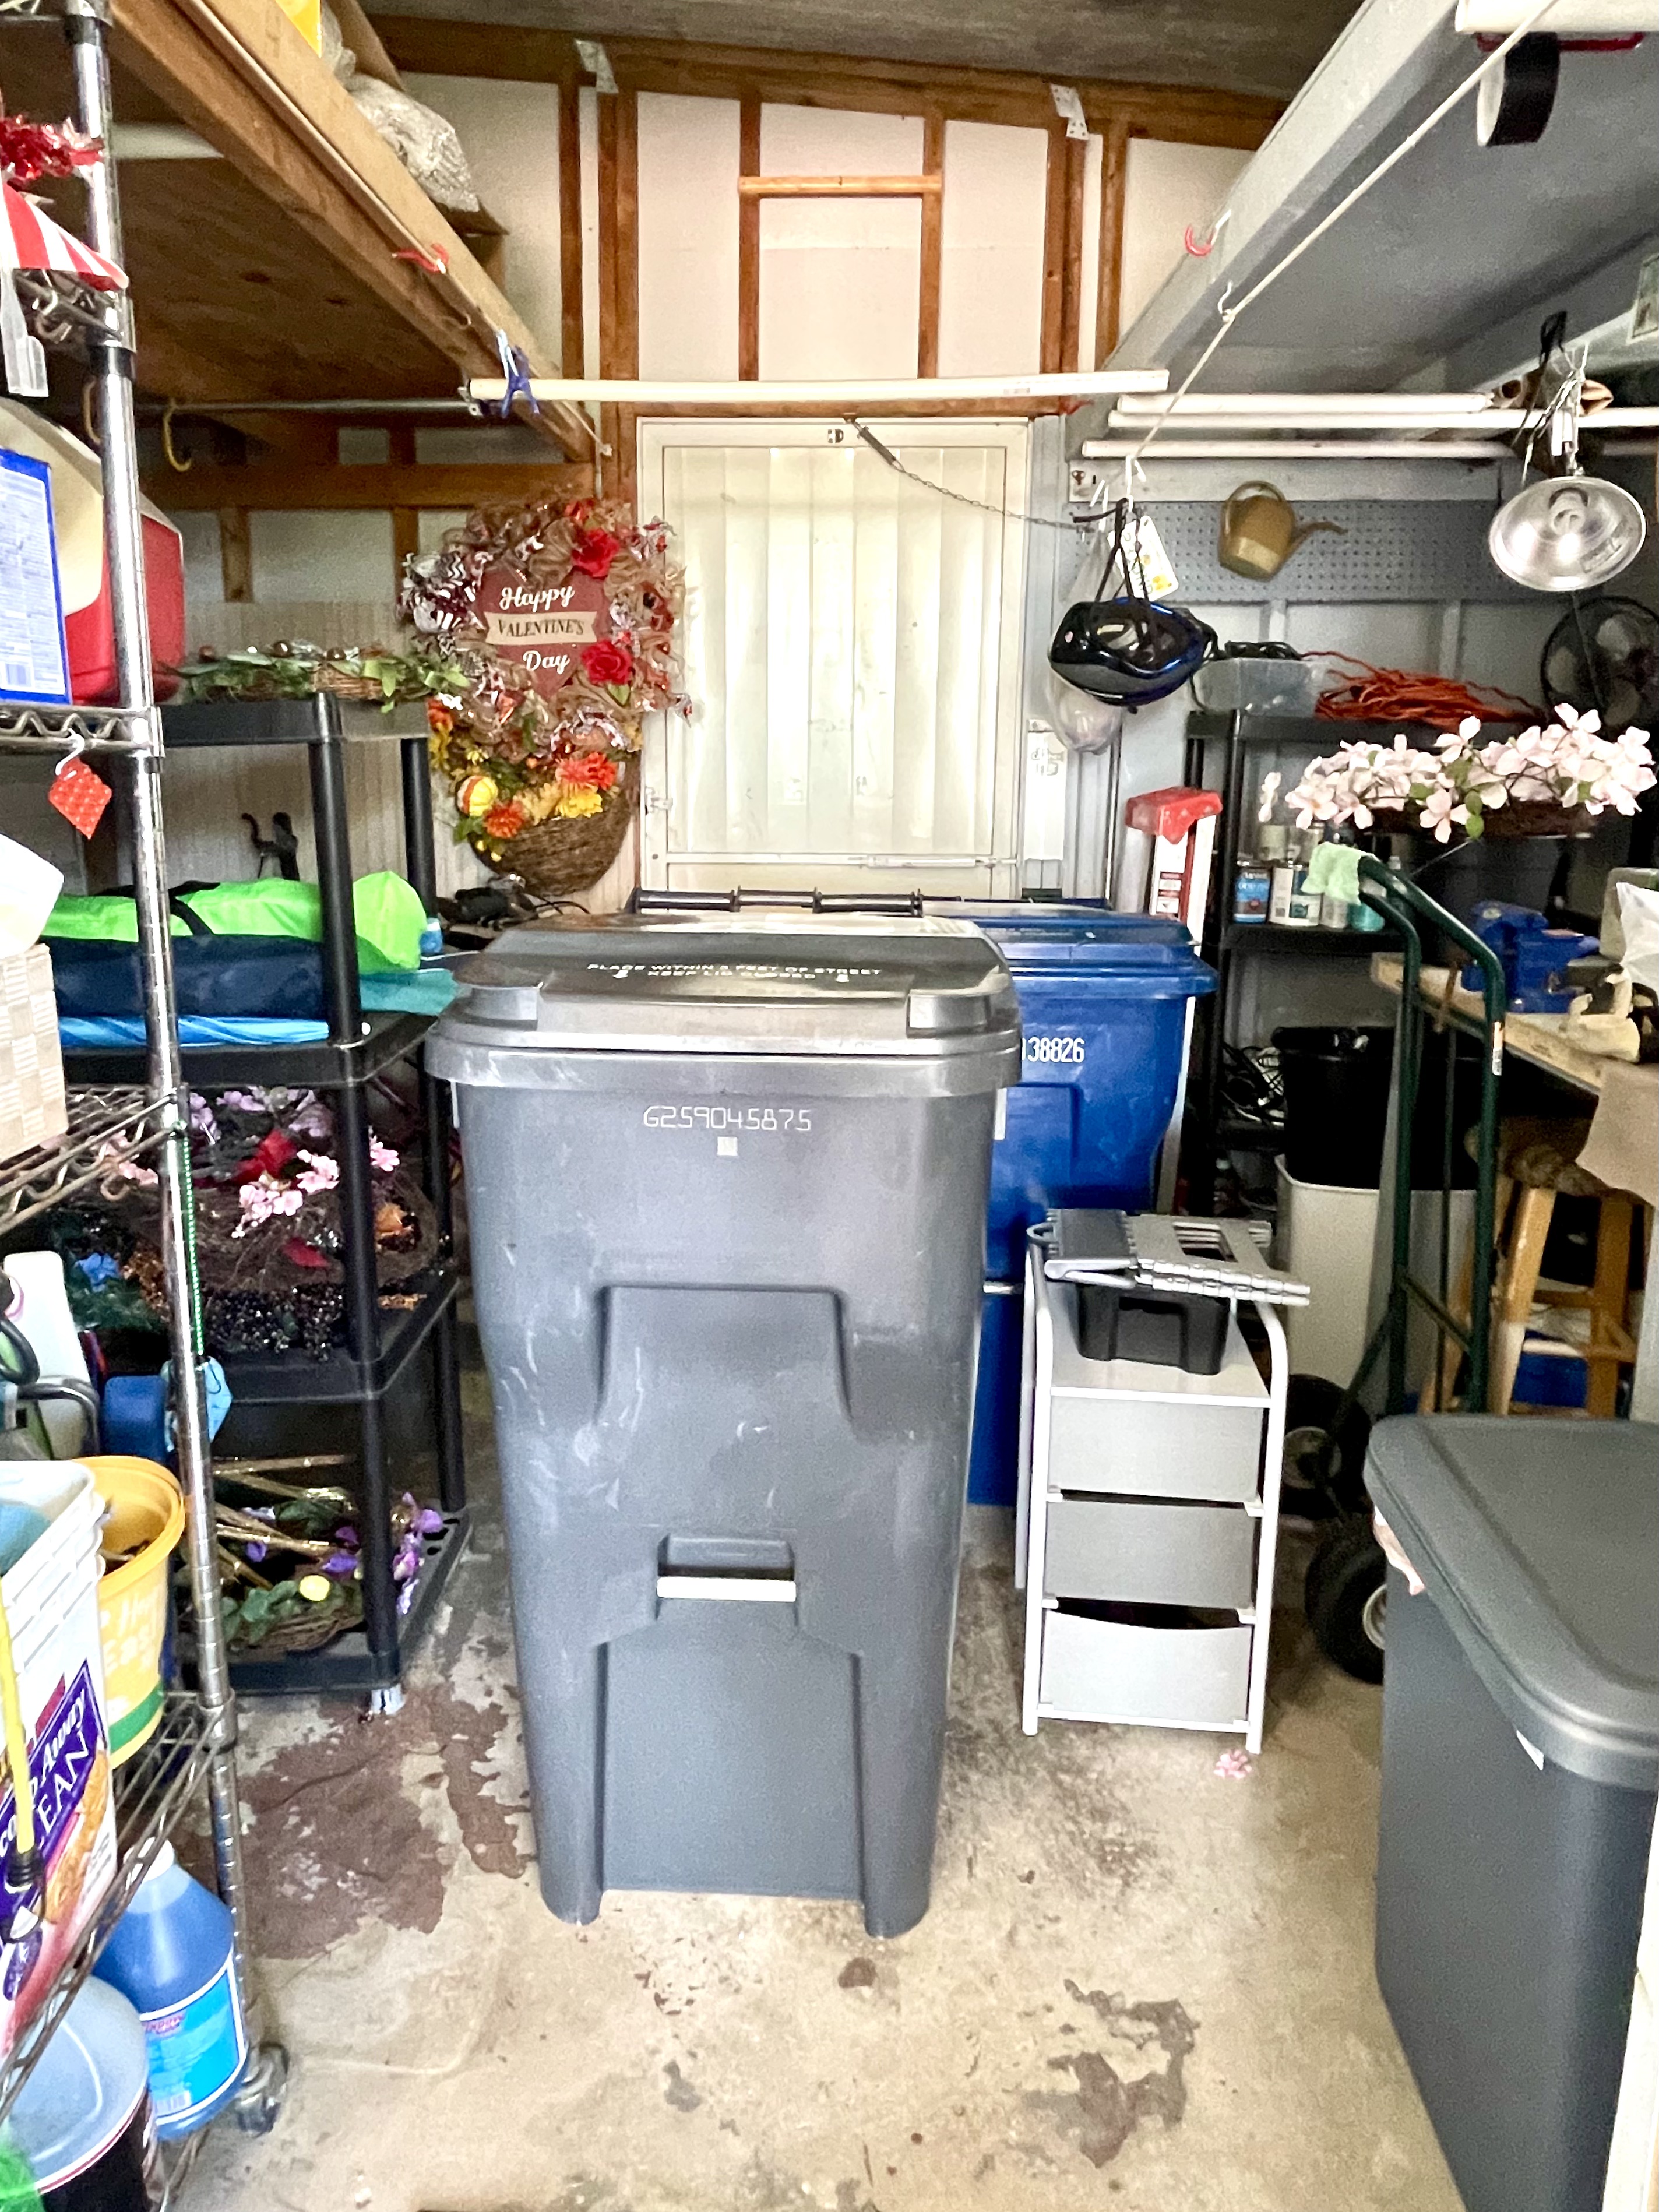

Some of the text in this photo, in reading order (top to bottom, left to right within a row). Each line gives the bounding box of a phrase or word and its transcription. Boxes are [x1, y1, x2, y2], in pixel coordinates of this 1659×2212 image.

[499, 585, 575, 612] Happy
[498, 619, 584, 637] VALENTINE'S
[523, 650, 570, 674] Day
[40, 1688, 84, 1788] Away
